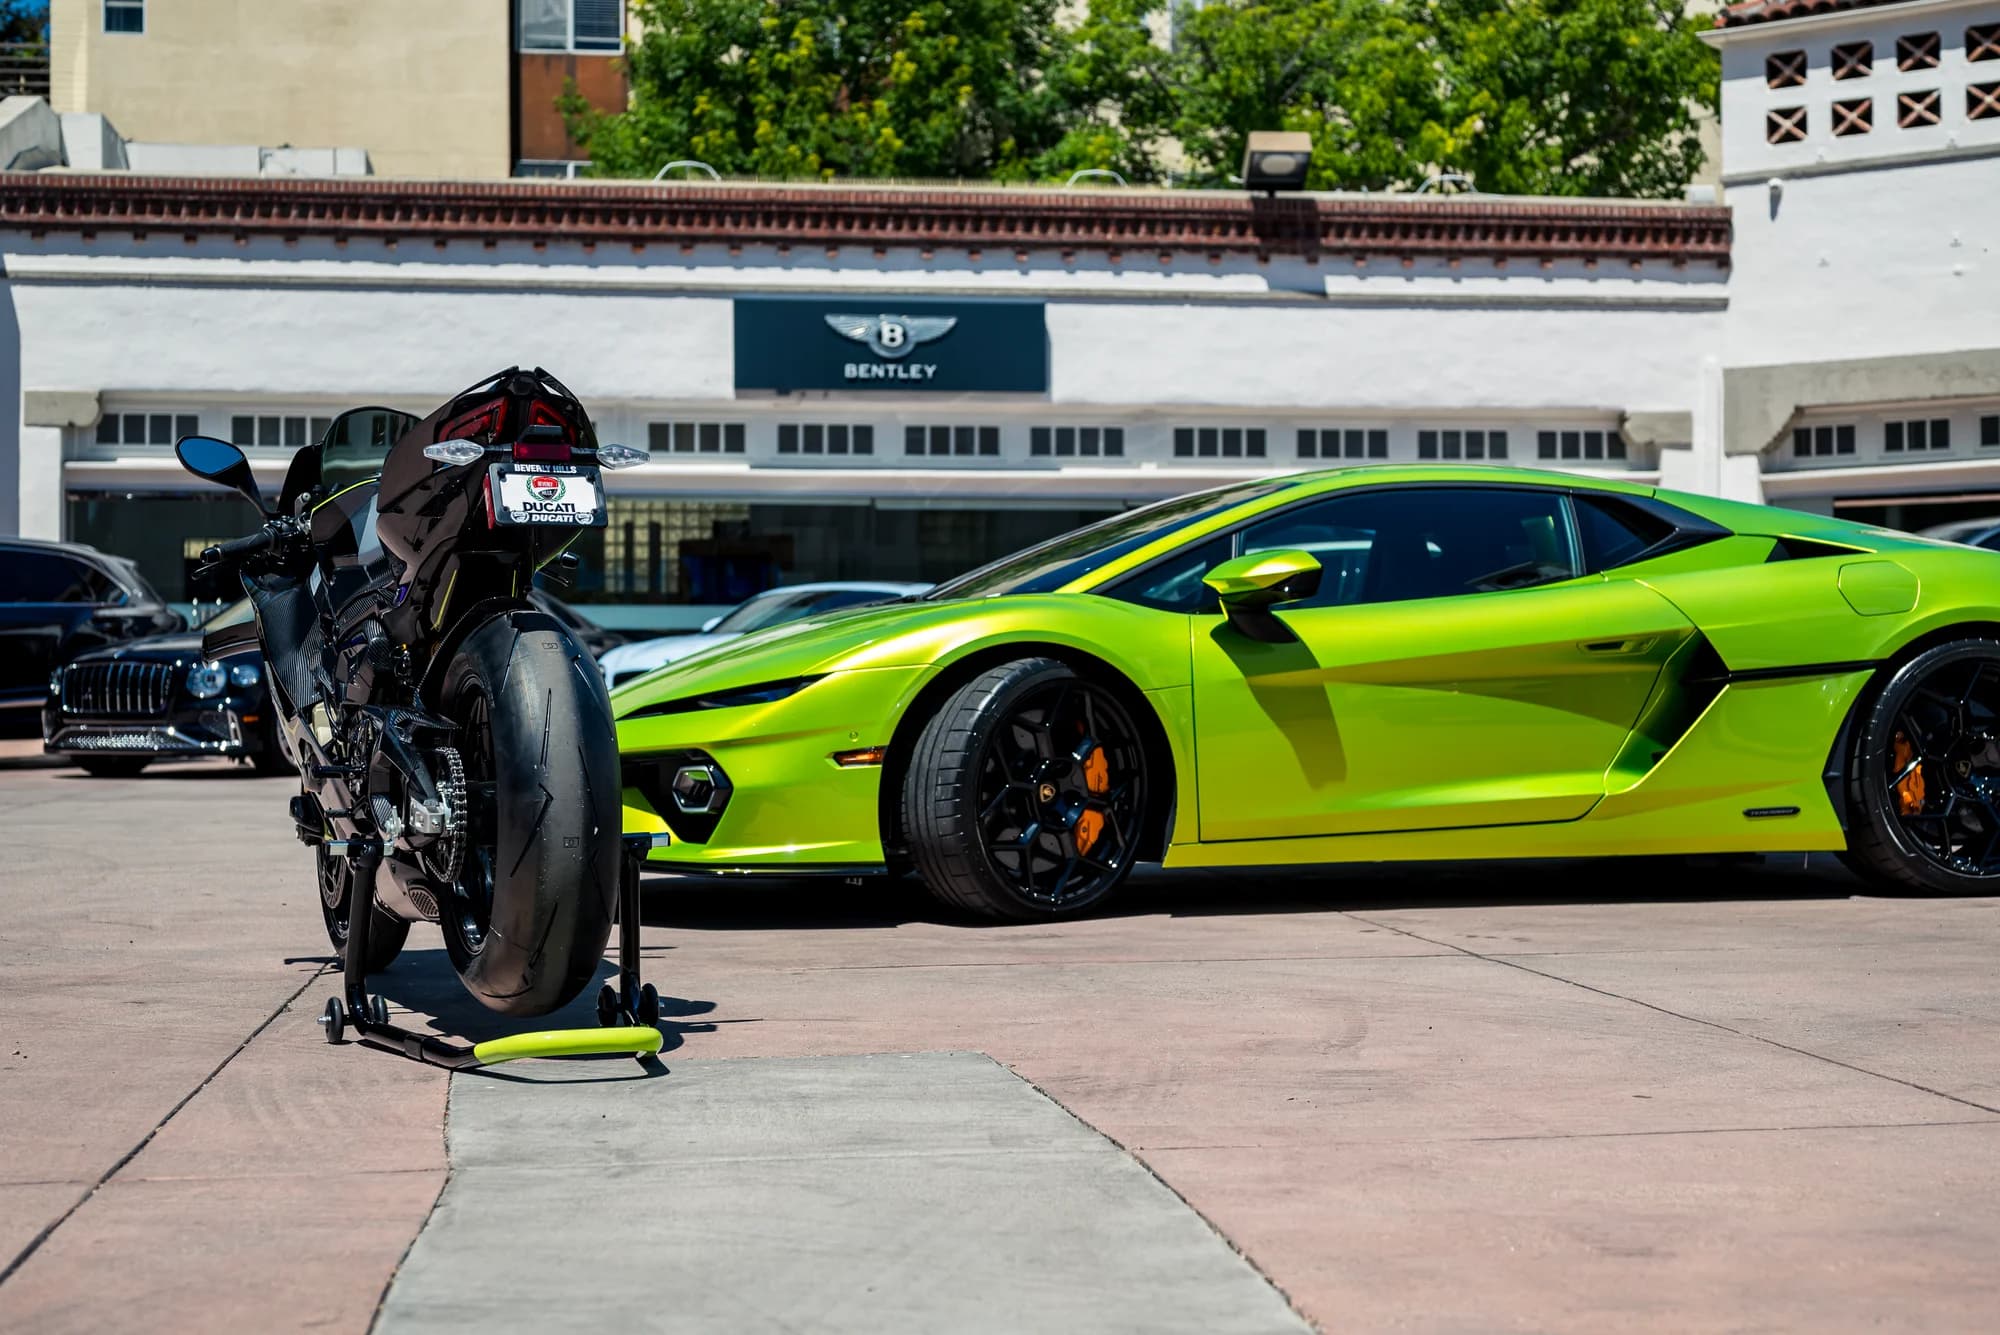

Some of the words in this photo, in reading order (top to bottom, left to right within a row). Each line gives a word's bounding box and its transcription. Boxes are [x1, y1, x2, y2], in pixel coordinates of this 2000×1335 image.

[880, 323, 904, 347] B
[844, 363, 937, 379] BENTLEY
[514, 464, 550, 472] BEVERLY
[552, 465, 577, 473] HILLS
[523, 502, 576, 512] DUCATI
[531, 514, 574, 522] DUCATI
